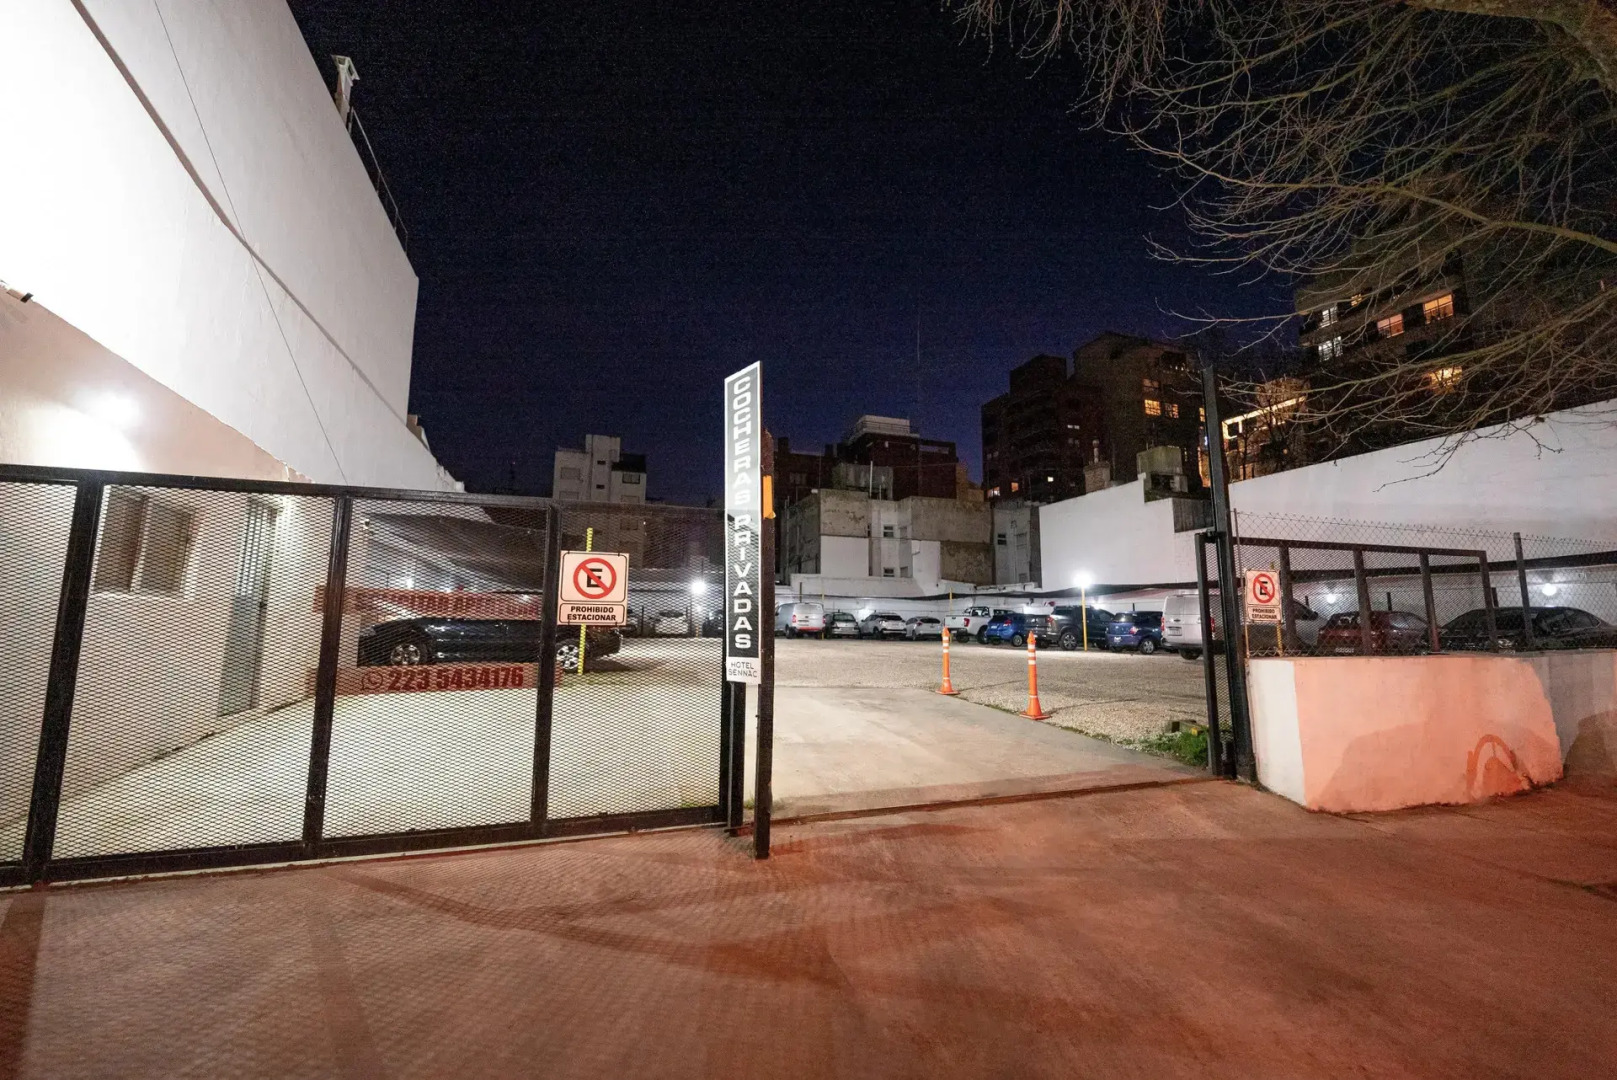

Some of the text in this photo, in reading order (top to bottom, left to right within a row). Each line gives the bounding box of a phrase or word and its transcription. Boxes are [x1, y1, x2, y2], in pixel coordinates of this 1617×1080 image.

[733, 375, 753, 649] COCHERAS PRIVADAS
[570, 605, 614, 613] PROHIBIDO
[567, 613, 616, 621] ESTACIONAR
[730, 661, 755, 670] HOTEL
[728, 669, 758, 678] SENNAC
[387, 666, 524, 692] 223 5434176
